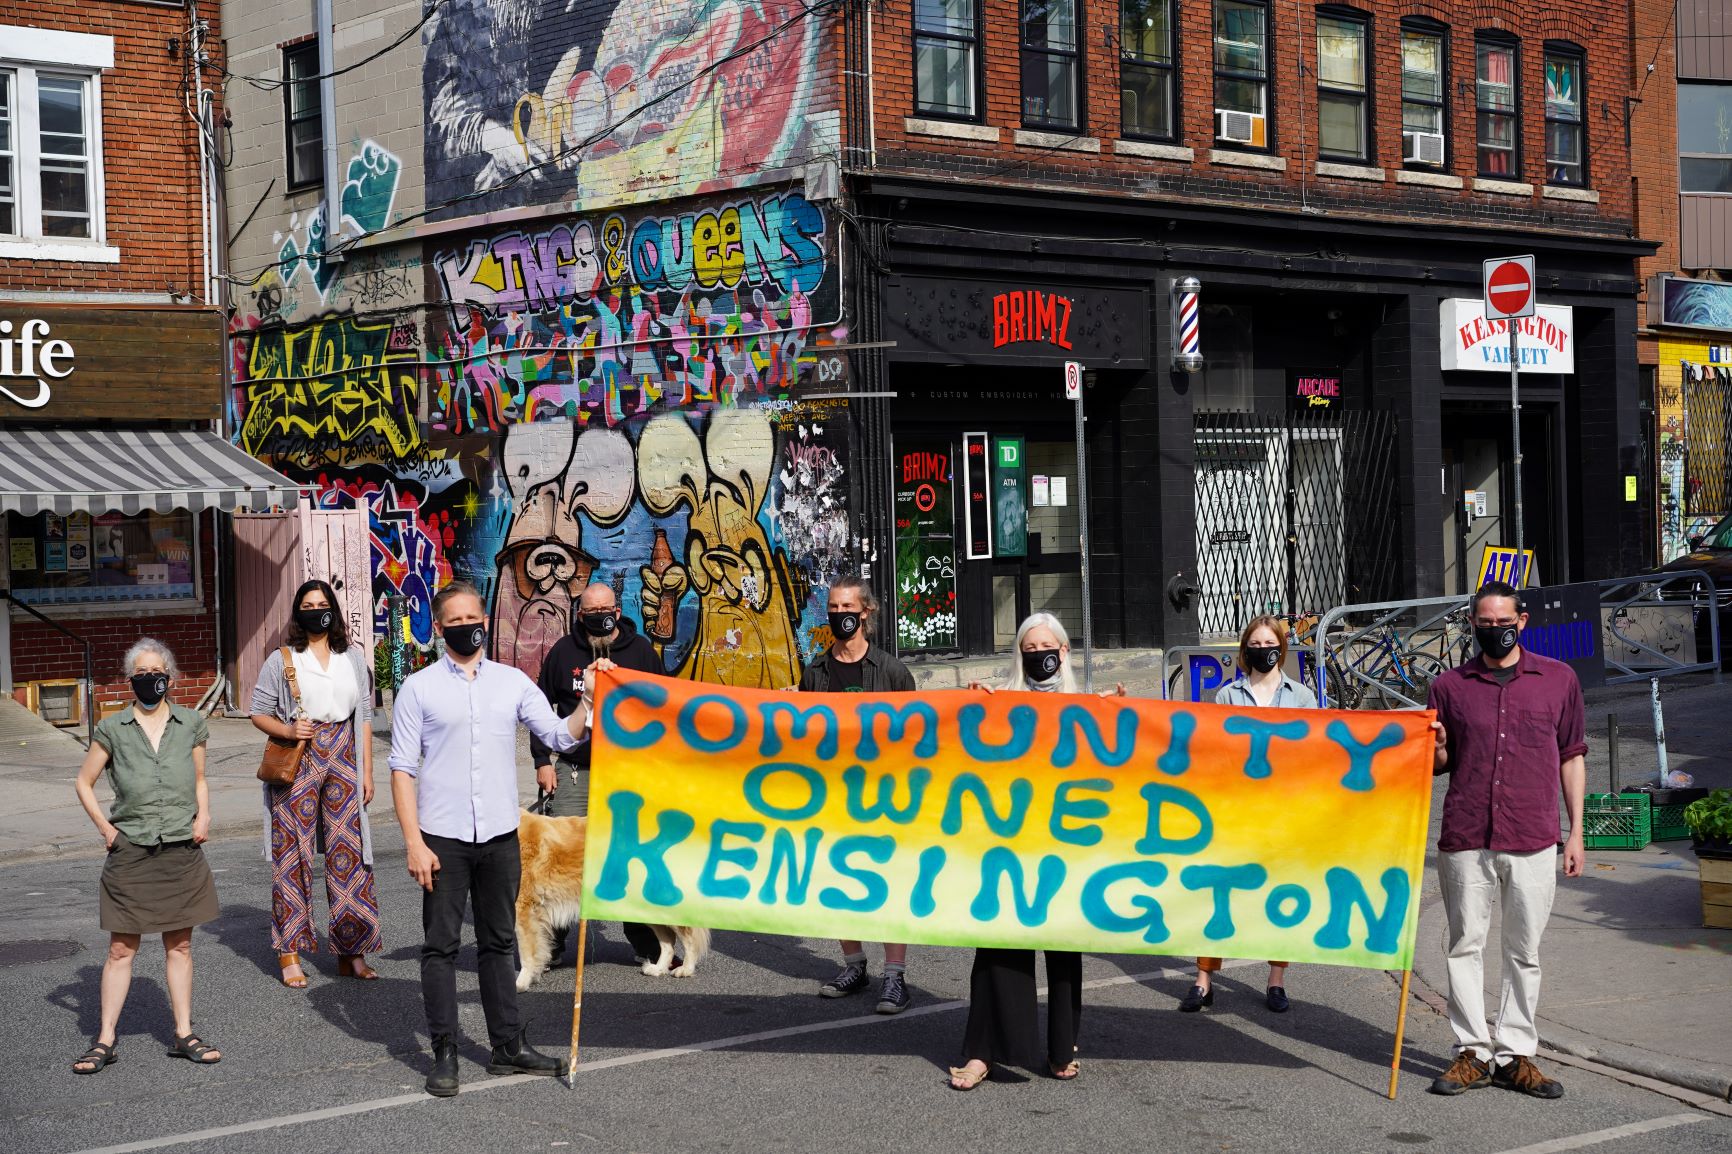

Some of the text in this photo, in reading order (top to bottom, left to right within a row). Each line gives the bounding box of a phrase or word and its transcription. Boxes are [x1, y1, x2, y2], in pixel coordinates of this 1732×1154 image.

[441, 194, 826, 333] KINGS & QUEENS
[993, 291, 1072, 350] BRIMZ
[1482, 346, 1548, 365] VARETY
[1296, 378, 1340, 396] ARCADE
[903, 452, 948, 483] BRIMZ
[1001, 446, 1017, 462] TD
[1518, 620, 1594, 662] ORONTO
[601, 681, 1406, 791] COMMUNITY
[743, 762, 1214, 855] OWNED
[594, 790, 1410, 955] KENSINGTON
